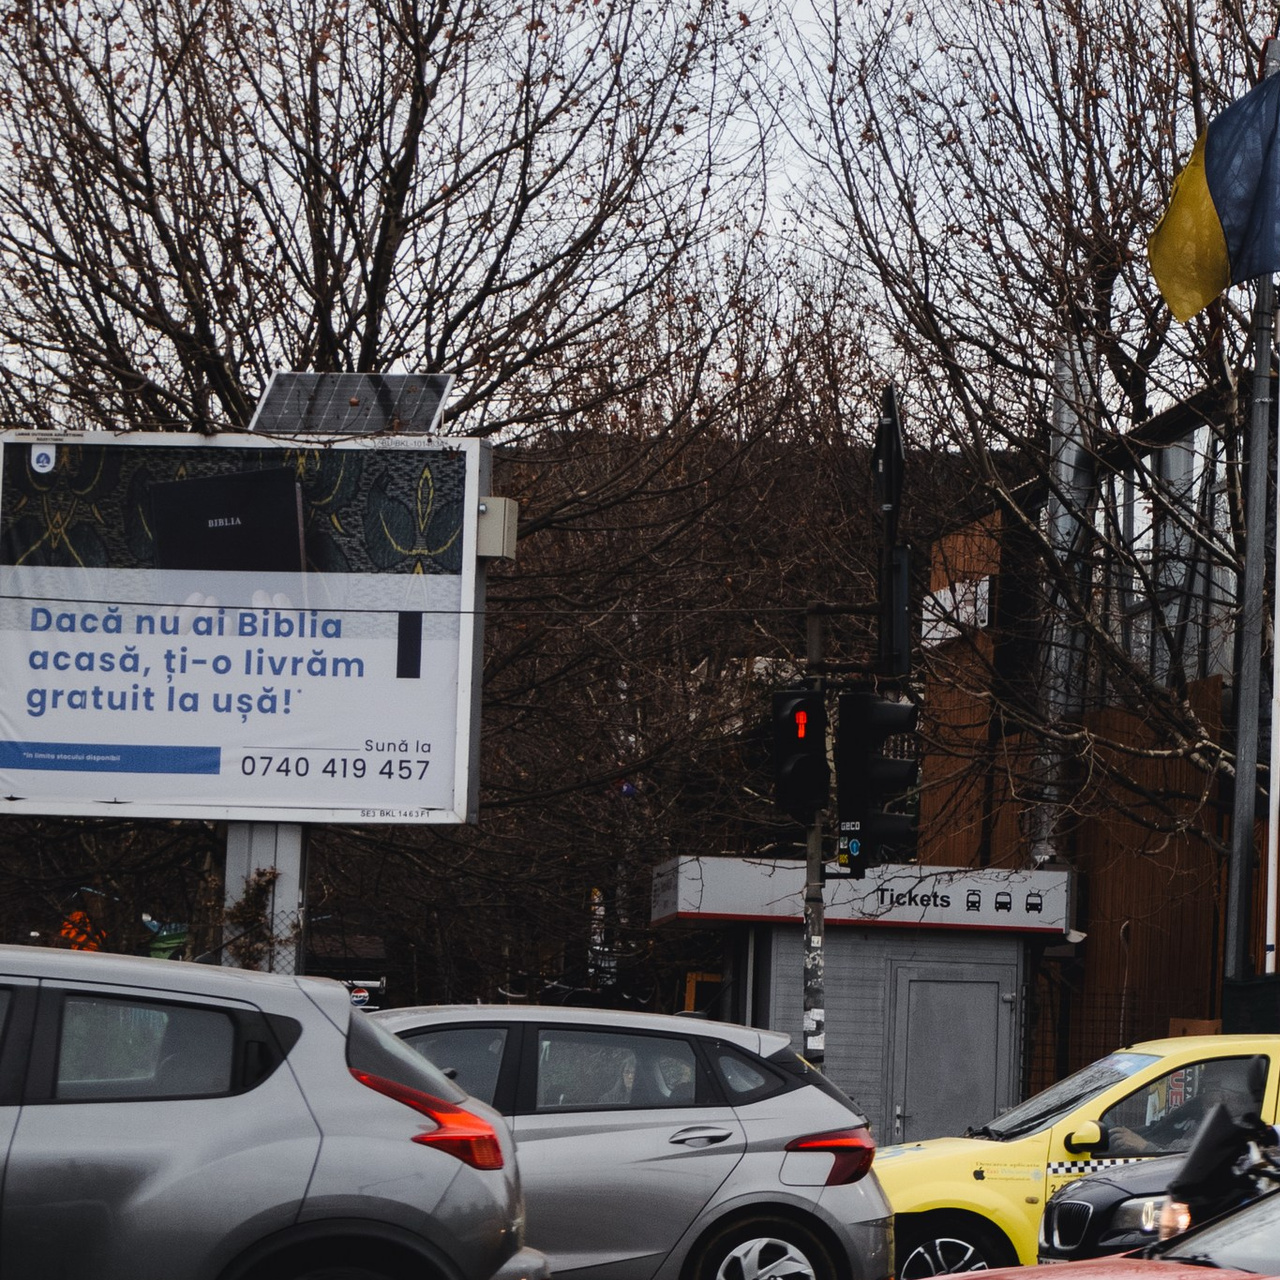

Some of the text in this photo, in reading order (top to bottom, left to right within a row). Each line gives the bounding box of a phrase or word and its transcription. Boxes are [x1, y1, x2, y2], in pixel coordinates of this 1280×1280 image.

[208, 517, 242, 528] BIBLIA
[30, 606, 342, 639] Dacă nu ai Biblia
[28, 645, 151, 678] acasă,
[244, 649, 365, 678] livrăm
[26, 683, 155, 717] gratuit
[167, 686, 199, 713] la
[364, 739, 431, 753] Sună la
[241, 755, 430, 780] 0740 419 457
[380, 809, 396, 818] BKL
[878, 887, 951, 908] Tickets
